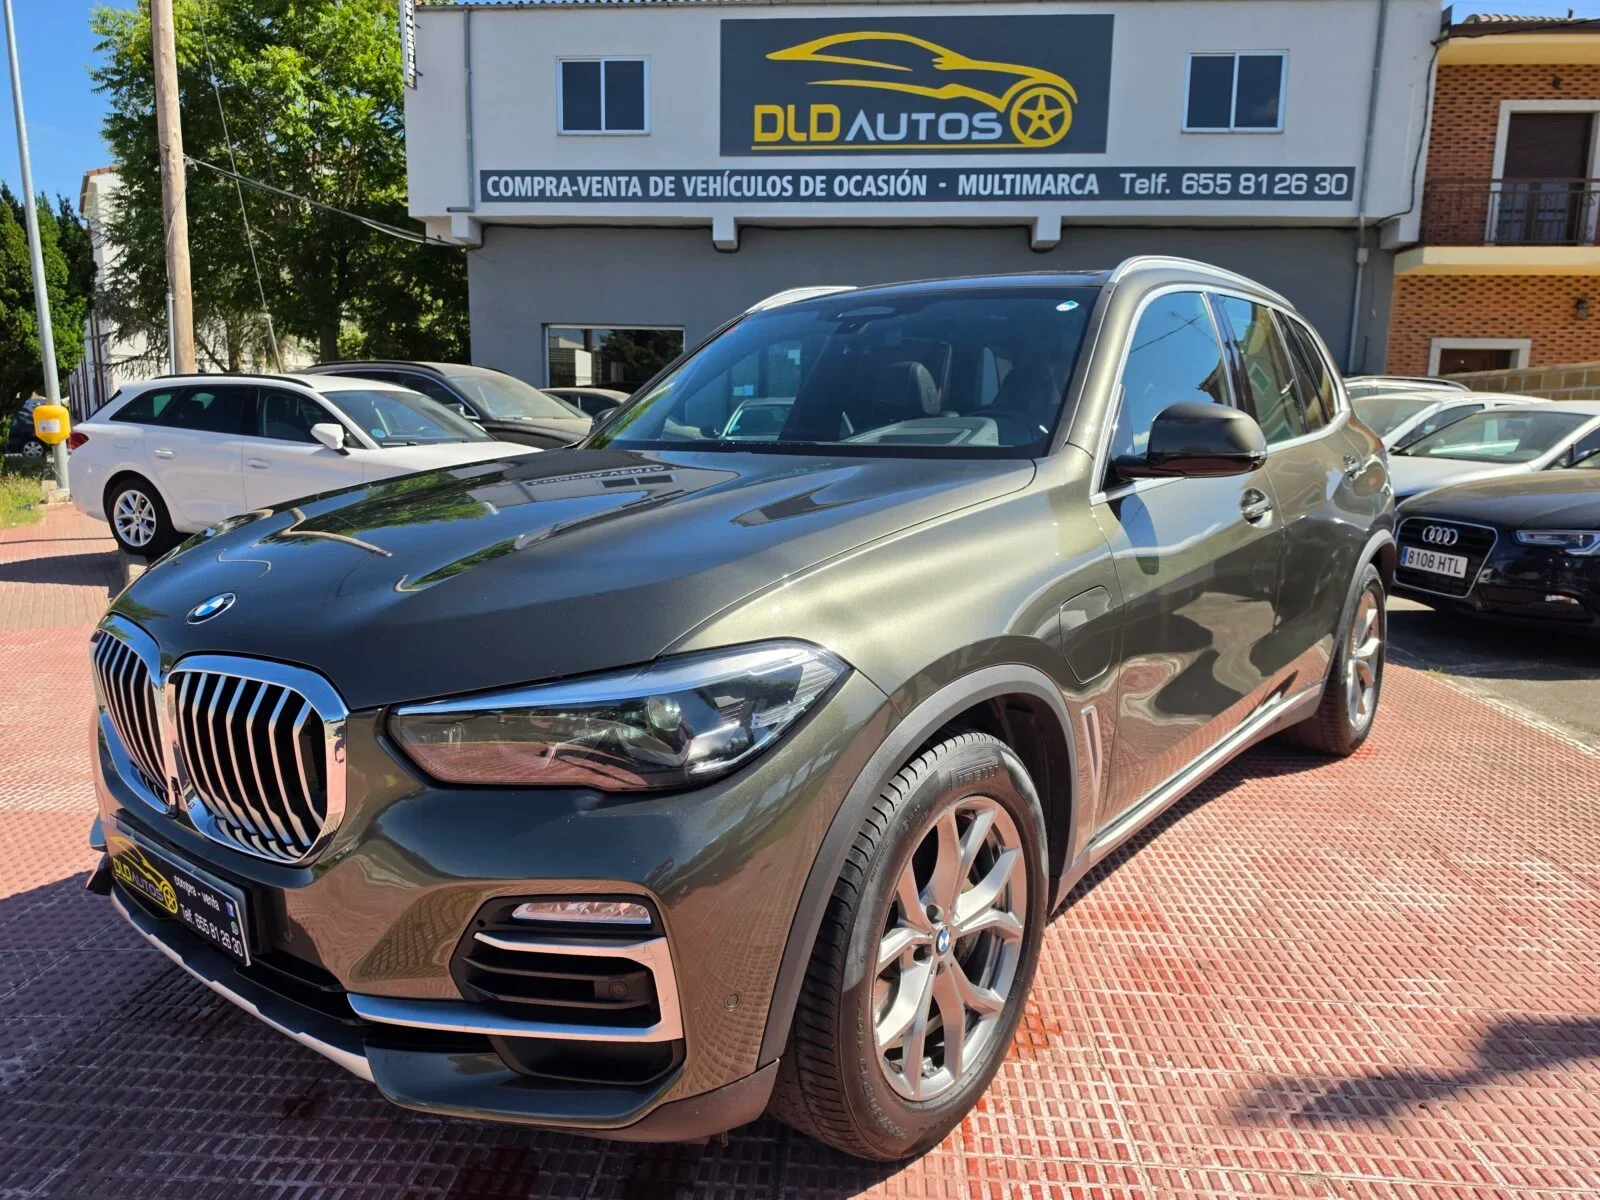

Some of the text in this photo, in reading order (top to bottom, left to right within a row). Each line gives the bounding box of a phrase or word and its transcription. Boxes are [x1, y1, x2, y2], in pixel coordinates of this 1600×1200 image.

[753, 104, 1003, 142] DLD AUTOS
[486, 174, 643, 197] COMPRA-VENTA
[649, 175, 676, 197] DE
[682, 169, 794, 197] VEHÍCULOS
[800, 174, 827, 197] DE
[833, 168, 928, 197] OCASIÓN
[957, 173, 1100, 196] MULTIMARCA
[1119, 172, 1171, 195] Telf.
[1181, 172, 1232, 195] 655
[1238, 172, 1268, 195] 81
[1273, 172, 1308, 195] 26
[1314, 172, 1349, 195] 30
[1408, 551, 1462, 575] 8108 HTL
[132, 870, 164, 902] AUTOS
[173, 874, 197, 897] compra
[202, 891, 220, 912] venta
[180, 903, 244, 958] Telf. 655 81 26 30
